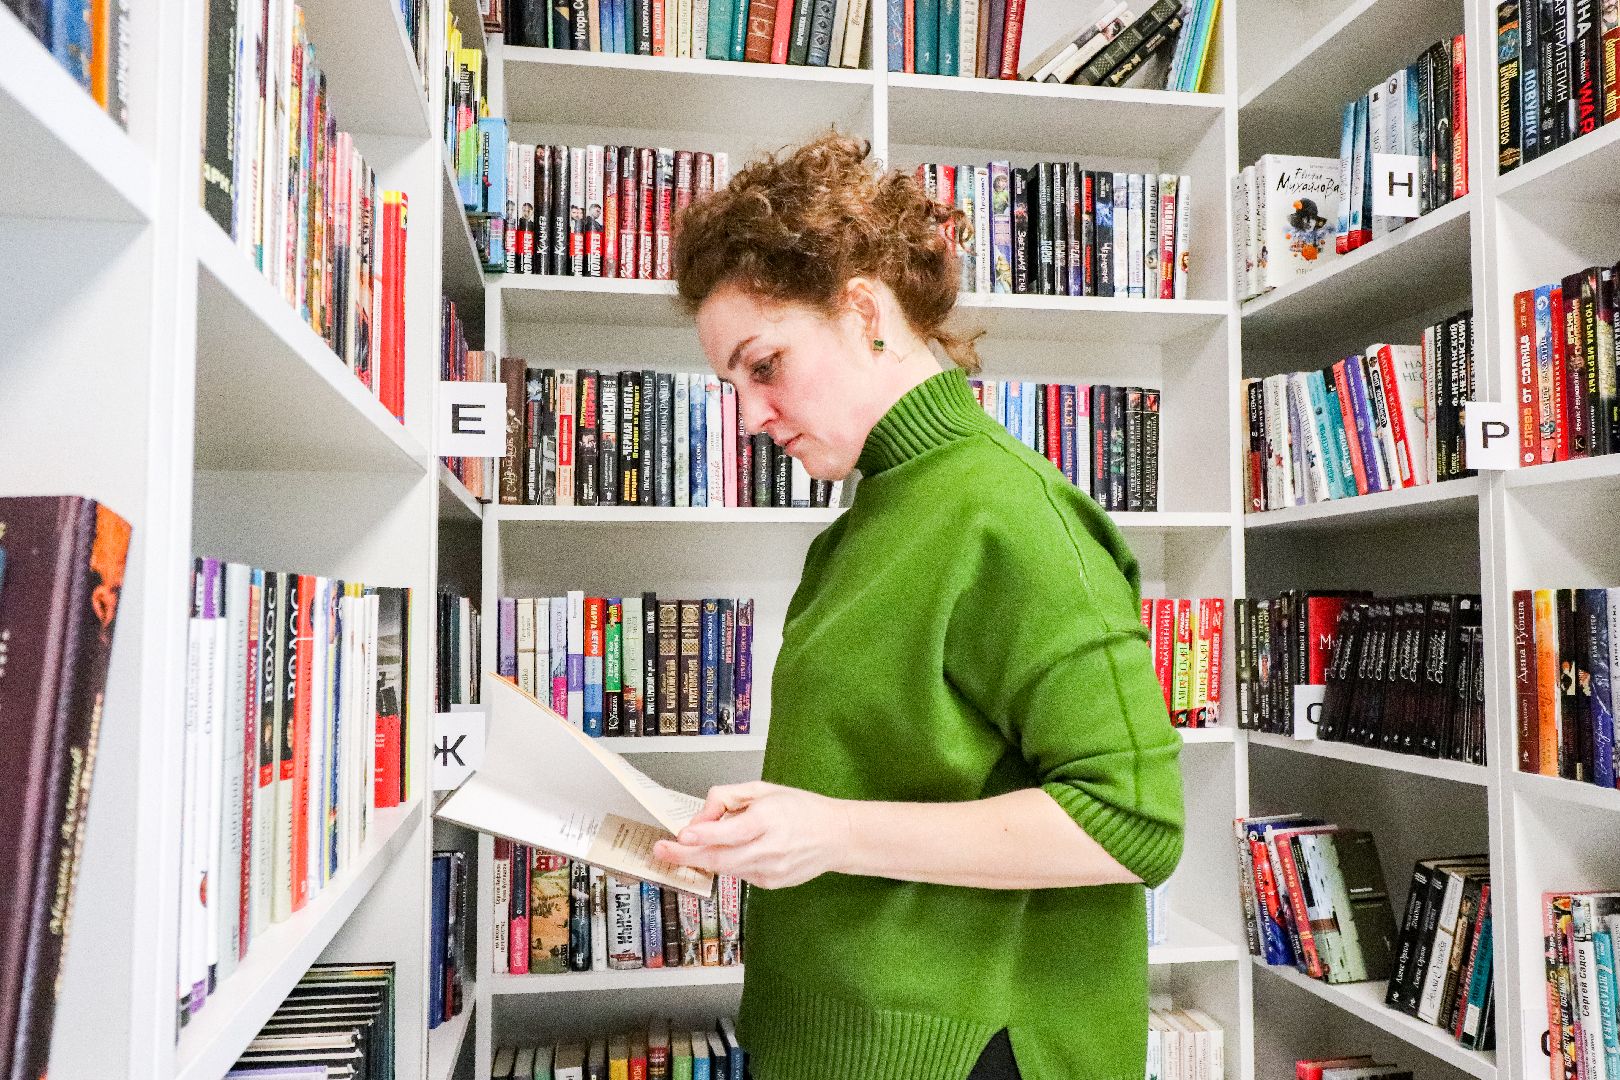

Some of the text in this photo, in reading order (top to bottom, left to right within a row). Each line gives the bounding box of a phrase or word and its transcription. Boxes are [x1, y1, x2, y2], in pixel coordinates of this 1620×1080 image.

[576, 10, 587, 39] Игорь
[642, 0, 650, 37] ГОЛОГРАМ
[945, 53, 952, 64] 2
[1509, 60, 1518, 78] НОЖ
[1555, 19, 1568, 103] ПРИЛЕПИН
[1579, 39, 1587, 84] ПРИЛЕПИН
[1500, 65, 1511, 145] ОСЛЕПИТЕЛЬНЫЙ
[1524, 69, 1538, 149] ЛОВУШКА
[1578, 80, 1595, 133] WAR
[1277, 171, 1341, 199] Михайлова
[1388, 172, 1413, 197] Н
[1450, 323, 1459, 407] Ф.НЕЗНАНСКИЙ
[1458, 319, 1467, 392] НЕЗНАНСКИЙ
[1519, 334, 1531, 385] СОЛНЦА
[1586, 302, 1598, 394] ТЮРЬМА МЕРТВЫХ
[643, 375, 653, 413] КРАМЕР
[658, 380, 669, 416] КРАМЕР
[1063, 394, 1074, 426] ЕСТЬ!
[1378, 352, 1401, 439] НАТАЛЬЯ НЕСТЕРОВА
[1522, 389, 1532, 404] ОТ
[452, 404, 485, 434] Е
[1481, 421, 1511, 448] Р
[759, 445, 768, 482] КОРСАКОВА
[779, 462, 787, 505] КОРСАКОВА
[590, 604, 599, 655] МАРТА КЕТРО
[1162, 603, 1171, 668] МАРИНИНА
[1515, 600, 1529, 645] Рубина
[261, 586, 274, 704] ВОЛОС
[1518, 649, 1529, 683] Дина
[434, 735, 467, 766] Ж
[1399, 942, 1410, 965] Орлов
[1414, 946, 1426, 967] Орлов
[1577, 948, 1591, 1017] Сергей Садов
[1563, 1051, 1573, 1068] БОГ
